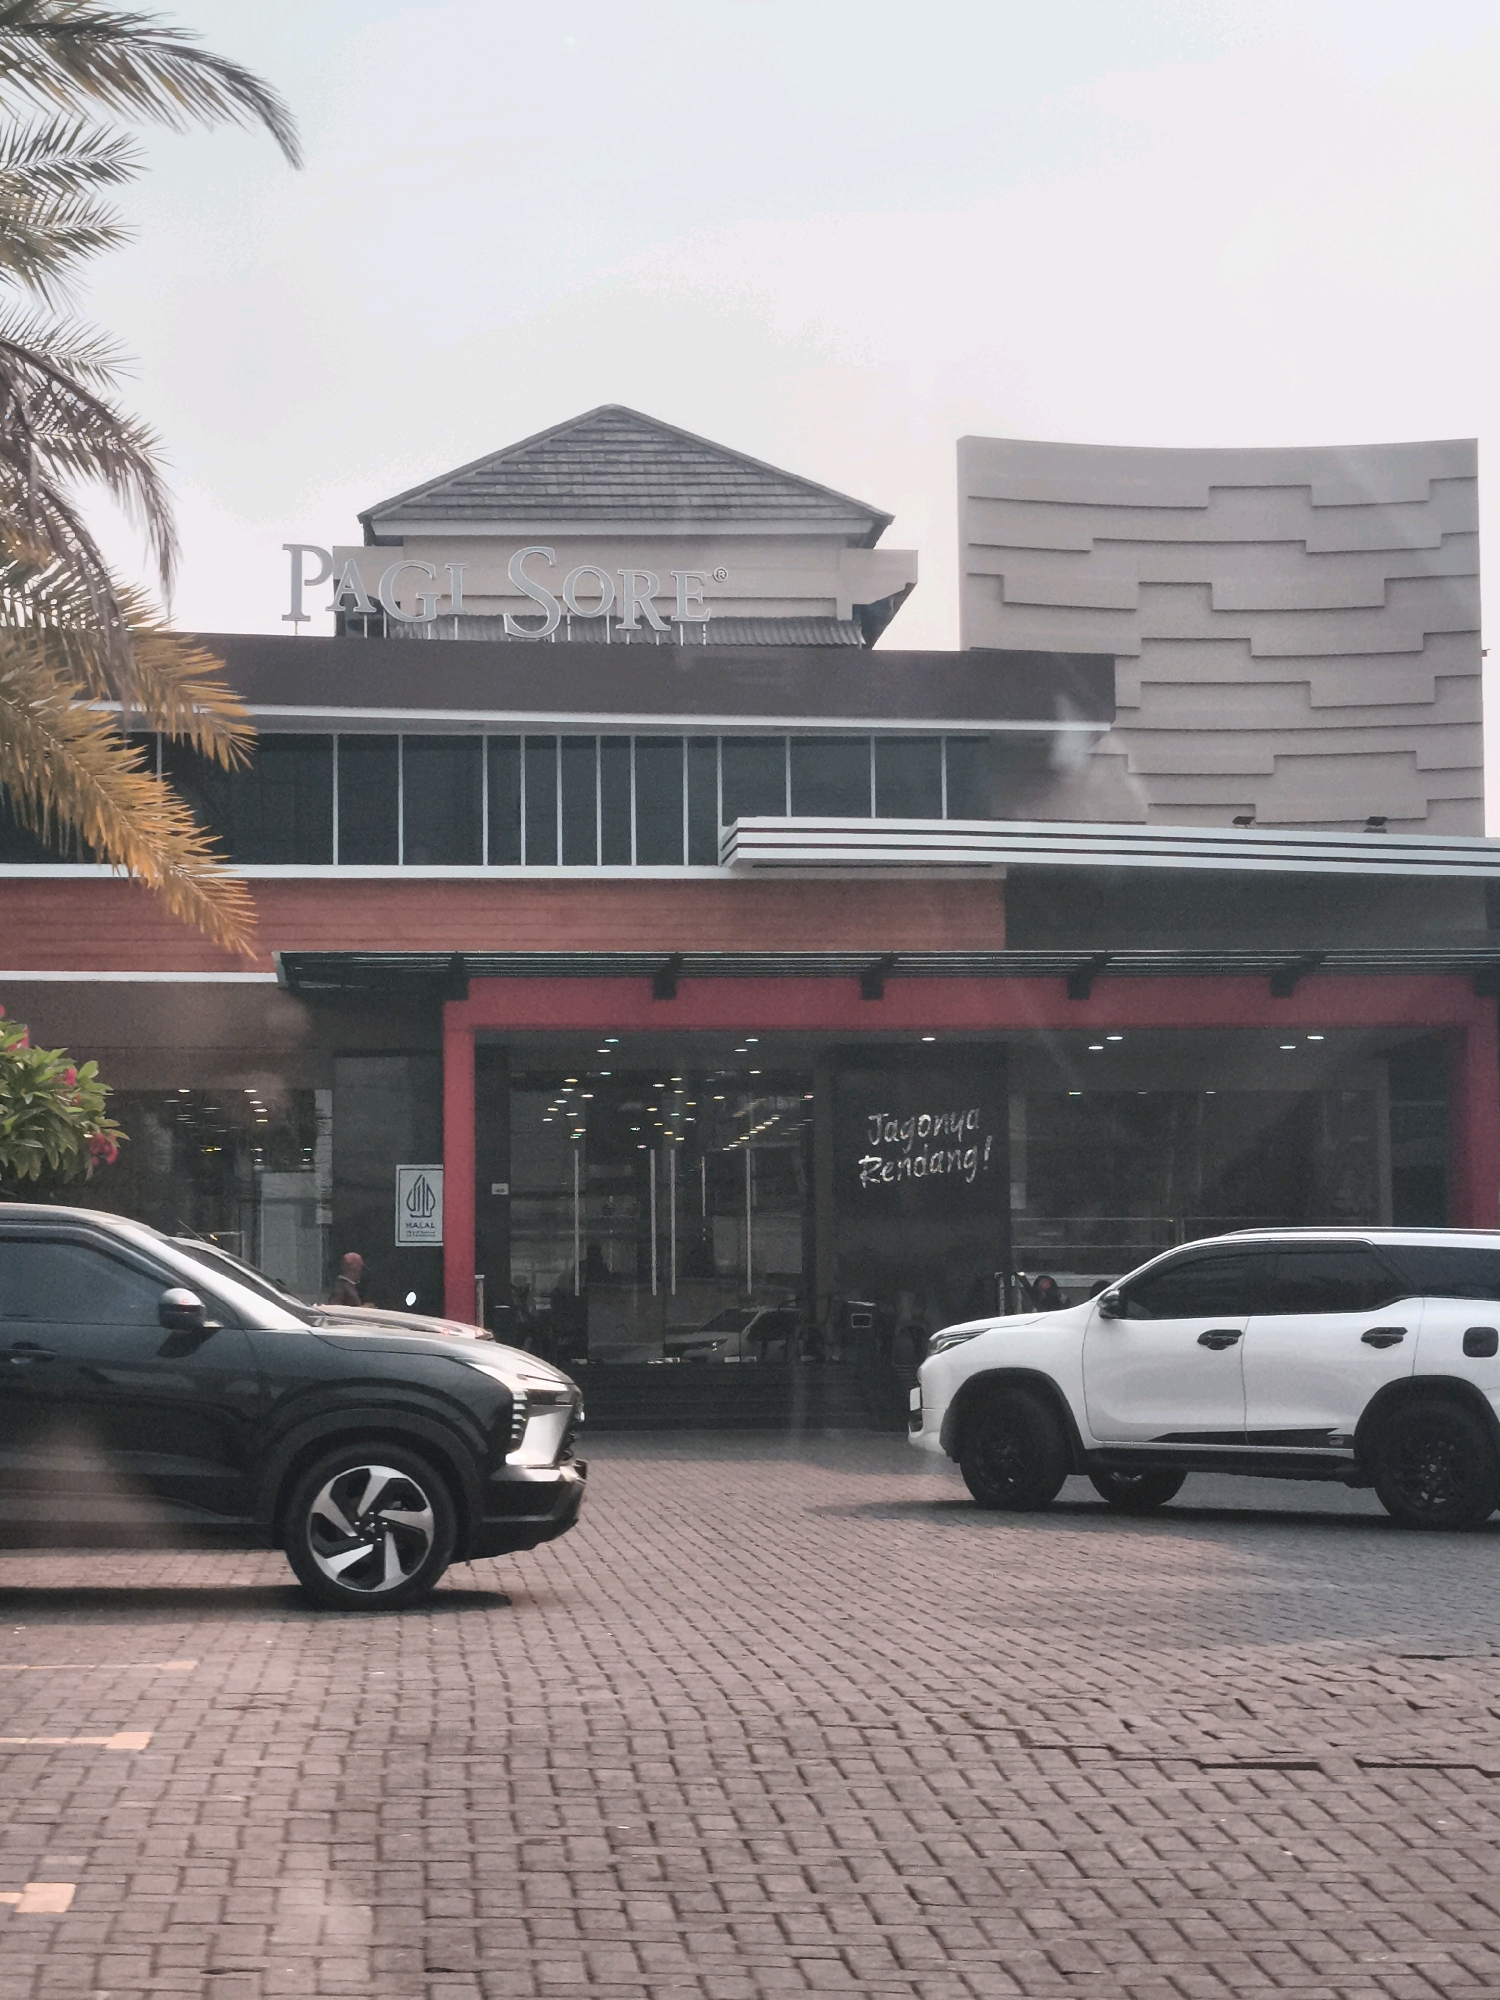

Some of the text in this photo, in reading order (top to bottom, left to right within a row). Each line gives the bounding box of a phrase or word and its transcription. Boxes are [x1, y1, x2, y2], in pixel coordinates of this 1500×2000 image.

[281, 543, 467, 622] PAGI
[868, 1108, 980, 1153] Jagonya
[858, 1135, 992, 1188] Rendang!
